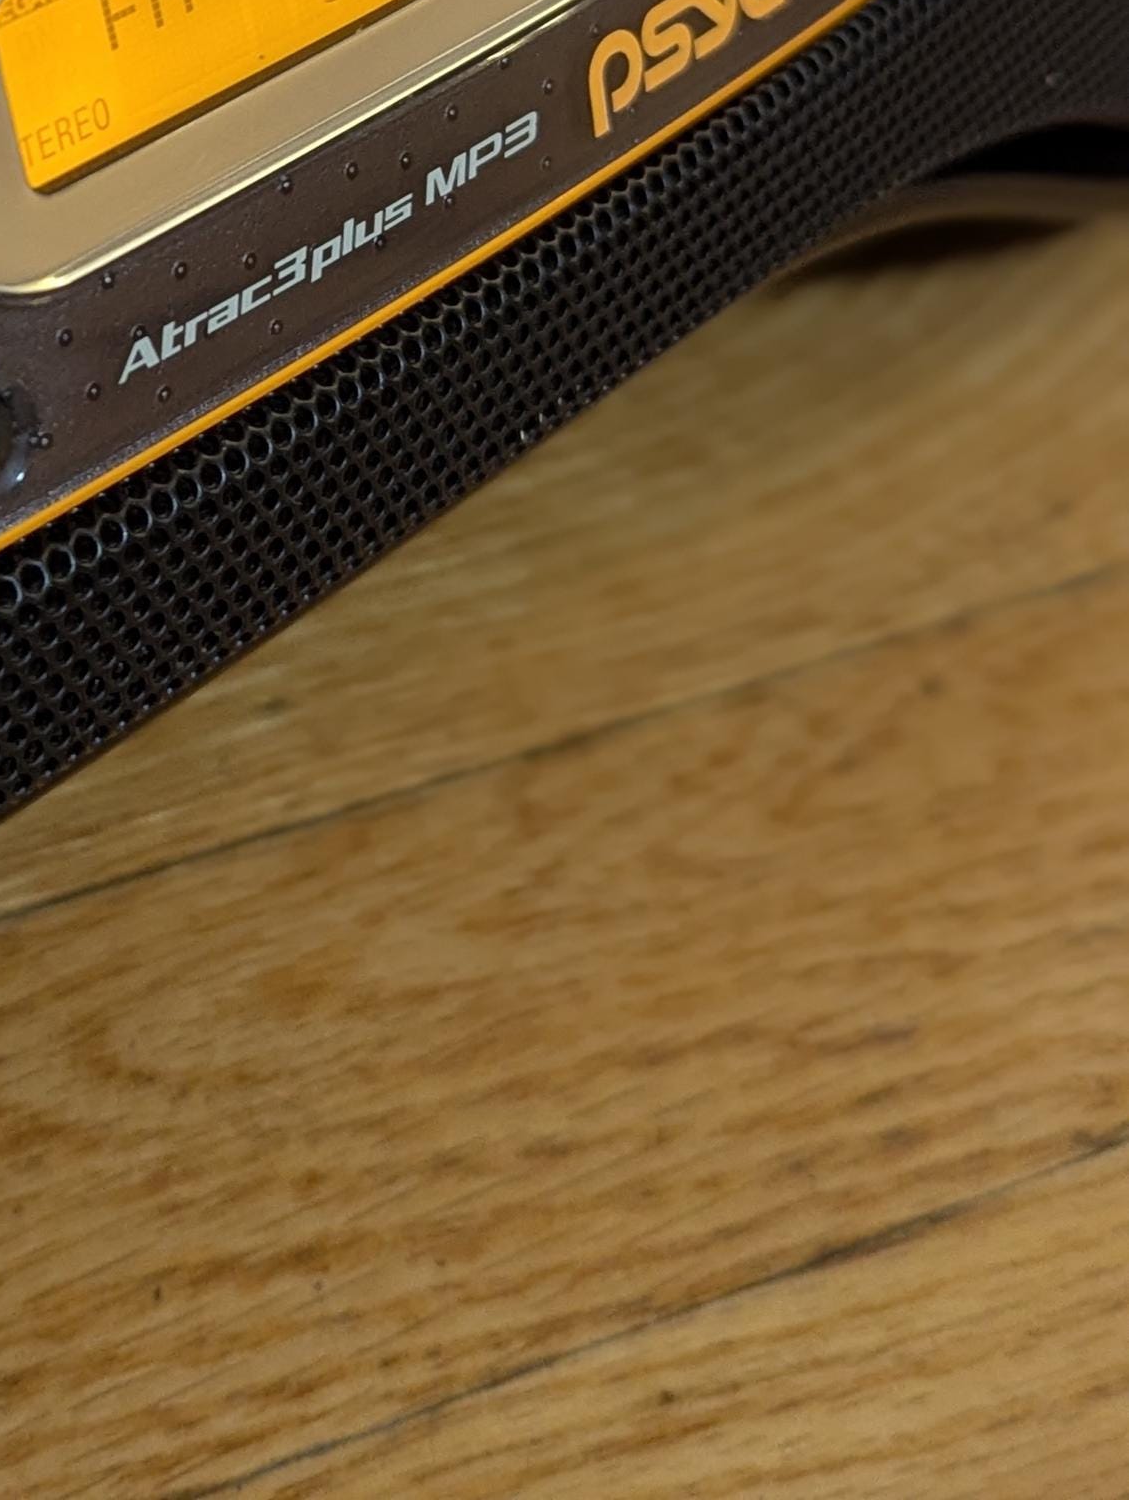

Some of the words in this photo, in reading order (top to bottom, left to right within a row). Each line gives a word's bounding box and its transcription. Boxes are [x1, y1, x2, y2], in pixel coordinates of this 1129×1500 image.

[22, 98, 110, 167] TEREO
[118, 193, 414, 385] Atrac3plus
[425, 111, 538, 206] MP3
